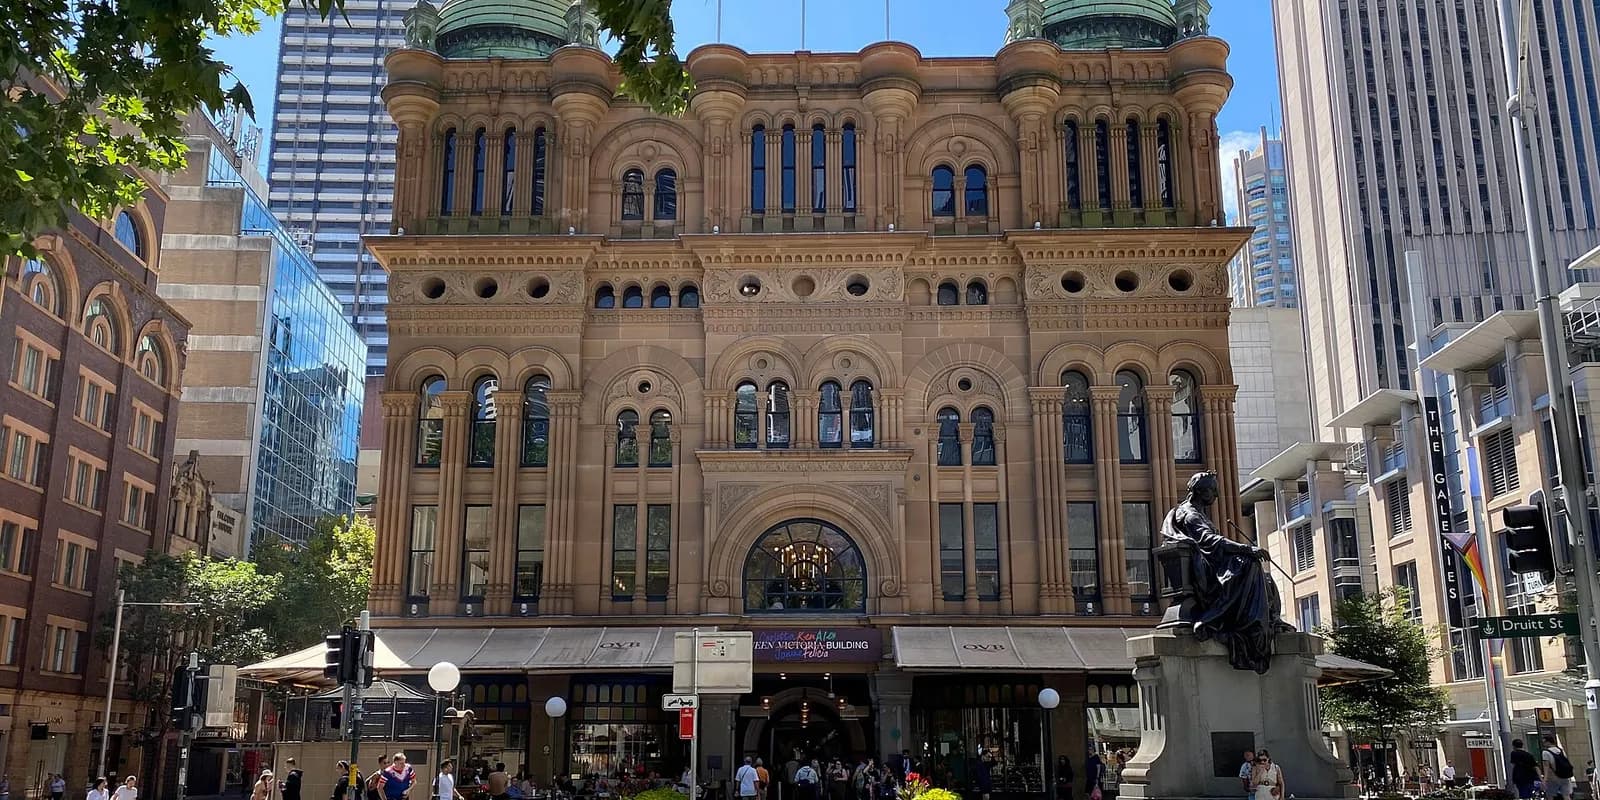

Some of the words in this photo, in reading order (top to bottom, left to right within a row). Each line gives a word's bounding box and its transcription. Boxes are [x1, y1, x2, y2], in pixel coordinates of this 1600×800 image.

[1428, 410, 1441, 452] THE
[1502, 619, 1545, 631] Druitt
[1549, 617, 1564, 629] St
[753, 641, 774, 650] EEN
[826, 641, 869, 650] BUILDING
